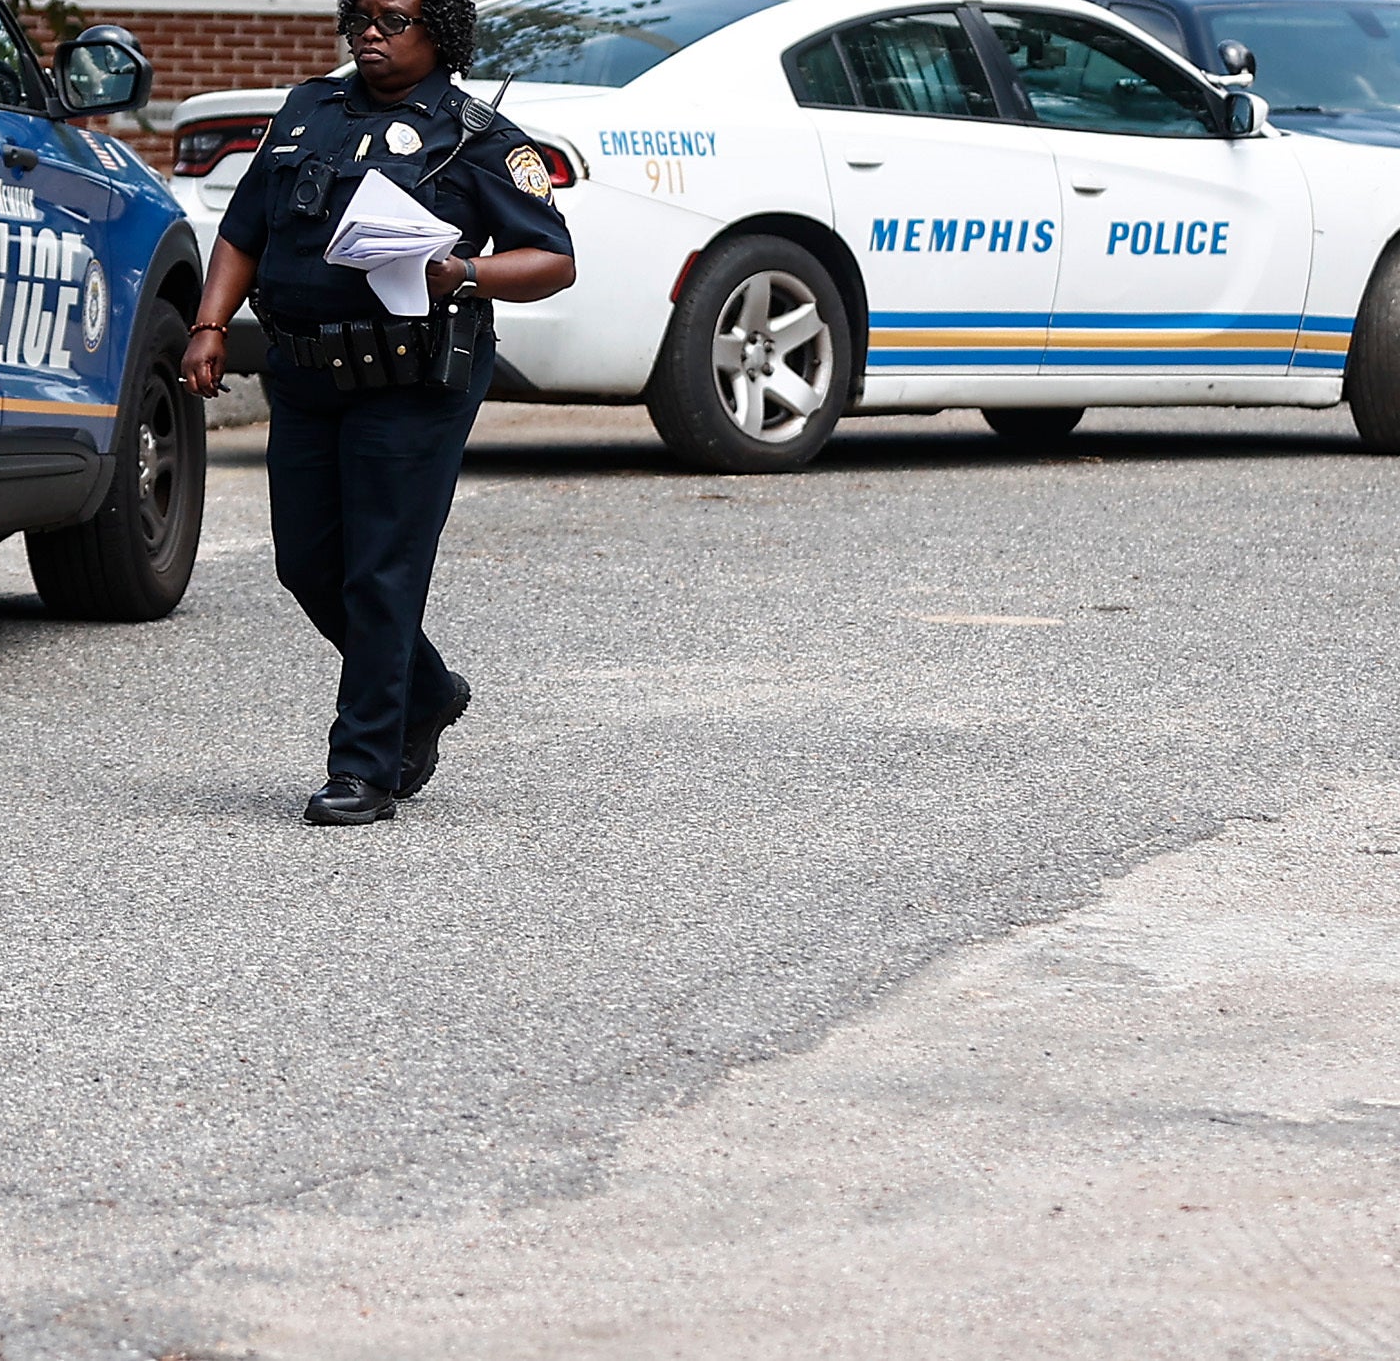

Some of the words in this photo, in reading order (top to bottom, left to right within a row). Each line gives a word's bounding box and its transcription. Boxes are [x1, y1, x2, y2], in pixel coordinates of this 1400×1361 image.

[600, 130, 717, 157] EMERGENCY
[645, 160, 685, 194] 911
[868, 219, 1055, 253] MEMPHIS
[1107, 221, 1230, 255] POLICE
